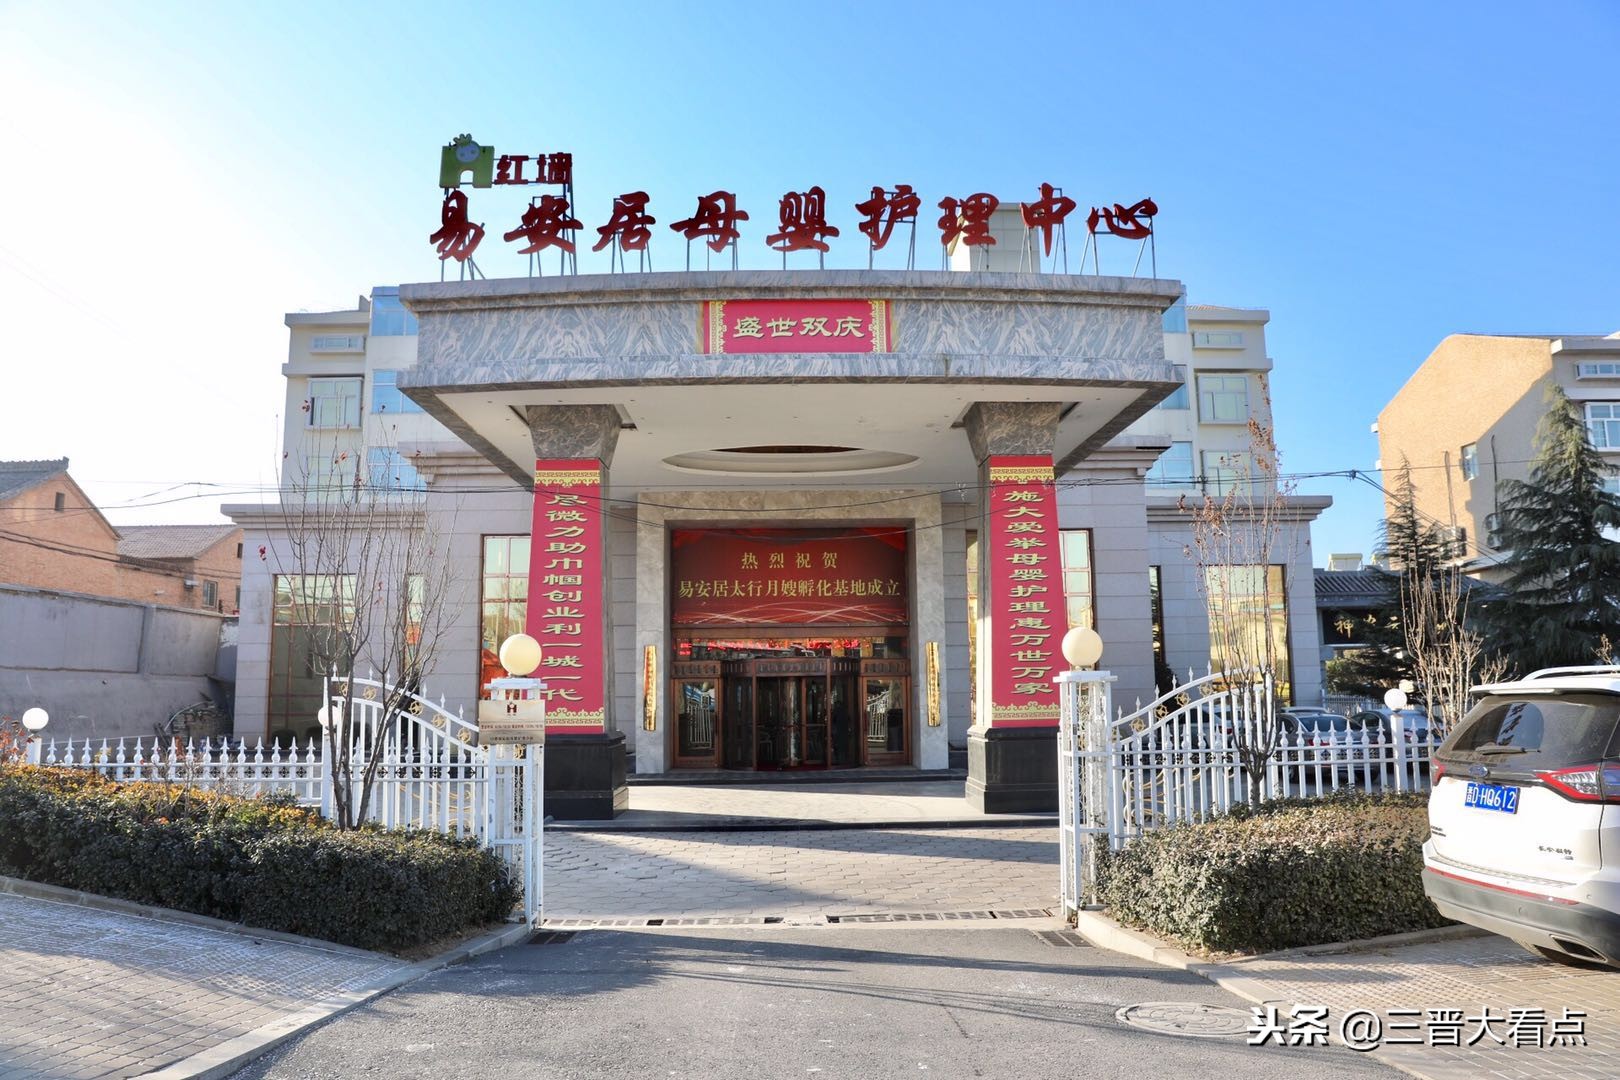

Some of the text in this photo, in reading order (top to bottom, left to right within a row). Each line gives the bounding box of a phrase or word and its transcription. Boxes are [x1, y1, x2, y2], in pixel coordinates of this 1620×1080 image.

[430, 181, 1159, 263] 易安居母婴护理中心
[733, 316, 865, 339] 盛世双庆
[741, 552, 838, 569] 热烈祝贺
[540, 494, 588, 702] 尽微力助巾帼创业利一城一代
[679, 579, 900, 598] 易安居太行月嫂孵化基地成立
[1002, 490, 1054, 695] 施大爱举母婴护理惠万世万家
